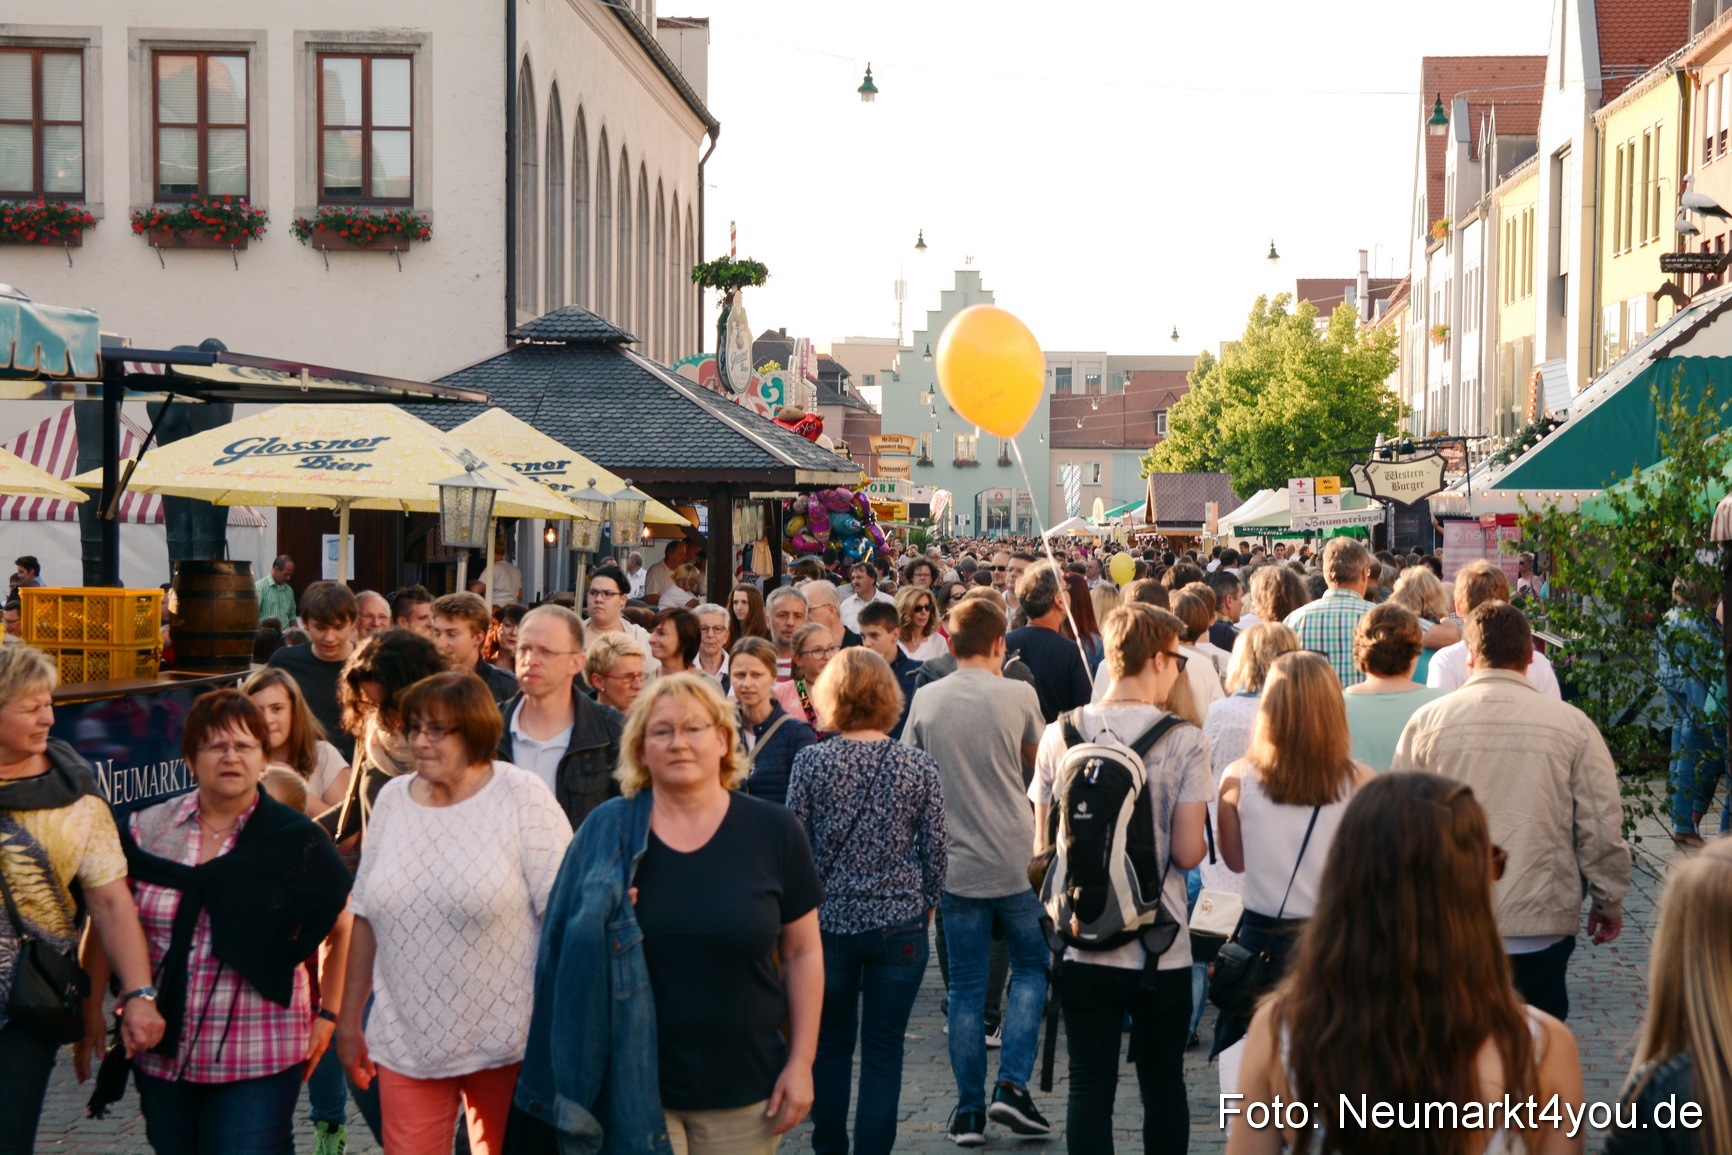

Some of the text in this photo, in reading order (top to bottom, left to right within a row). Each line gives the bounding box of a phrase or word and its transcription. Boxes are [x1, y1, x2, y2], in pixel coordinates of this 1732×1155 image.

[213, 436, 391, 466] Glossner
[295, 454, 373, 471] Bier
[1391, 481, 1425, 492] Burger
[1305, 513, 1383, 527] Baumstriezel
